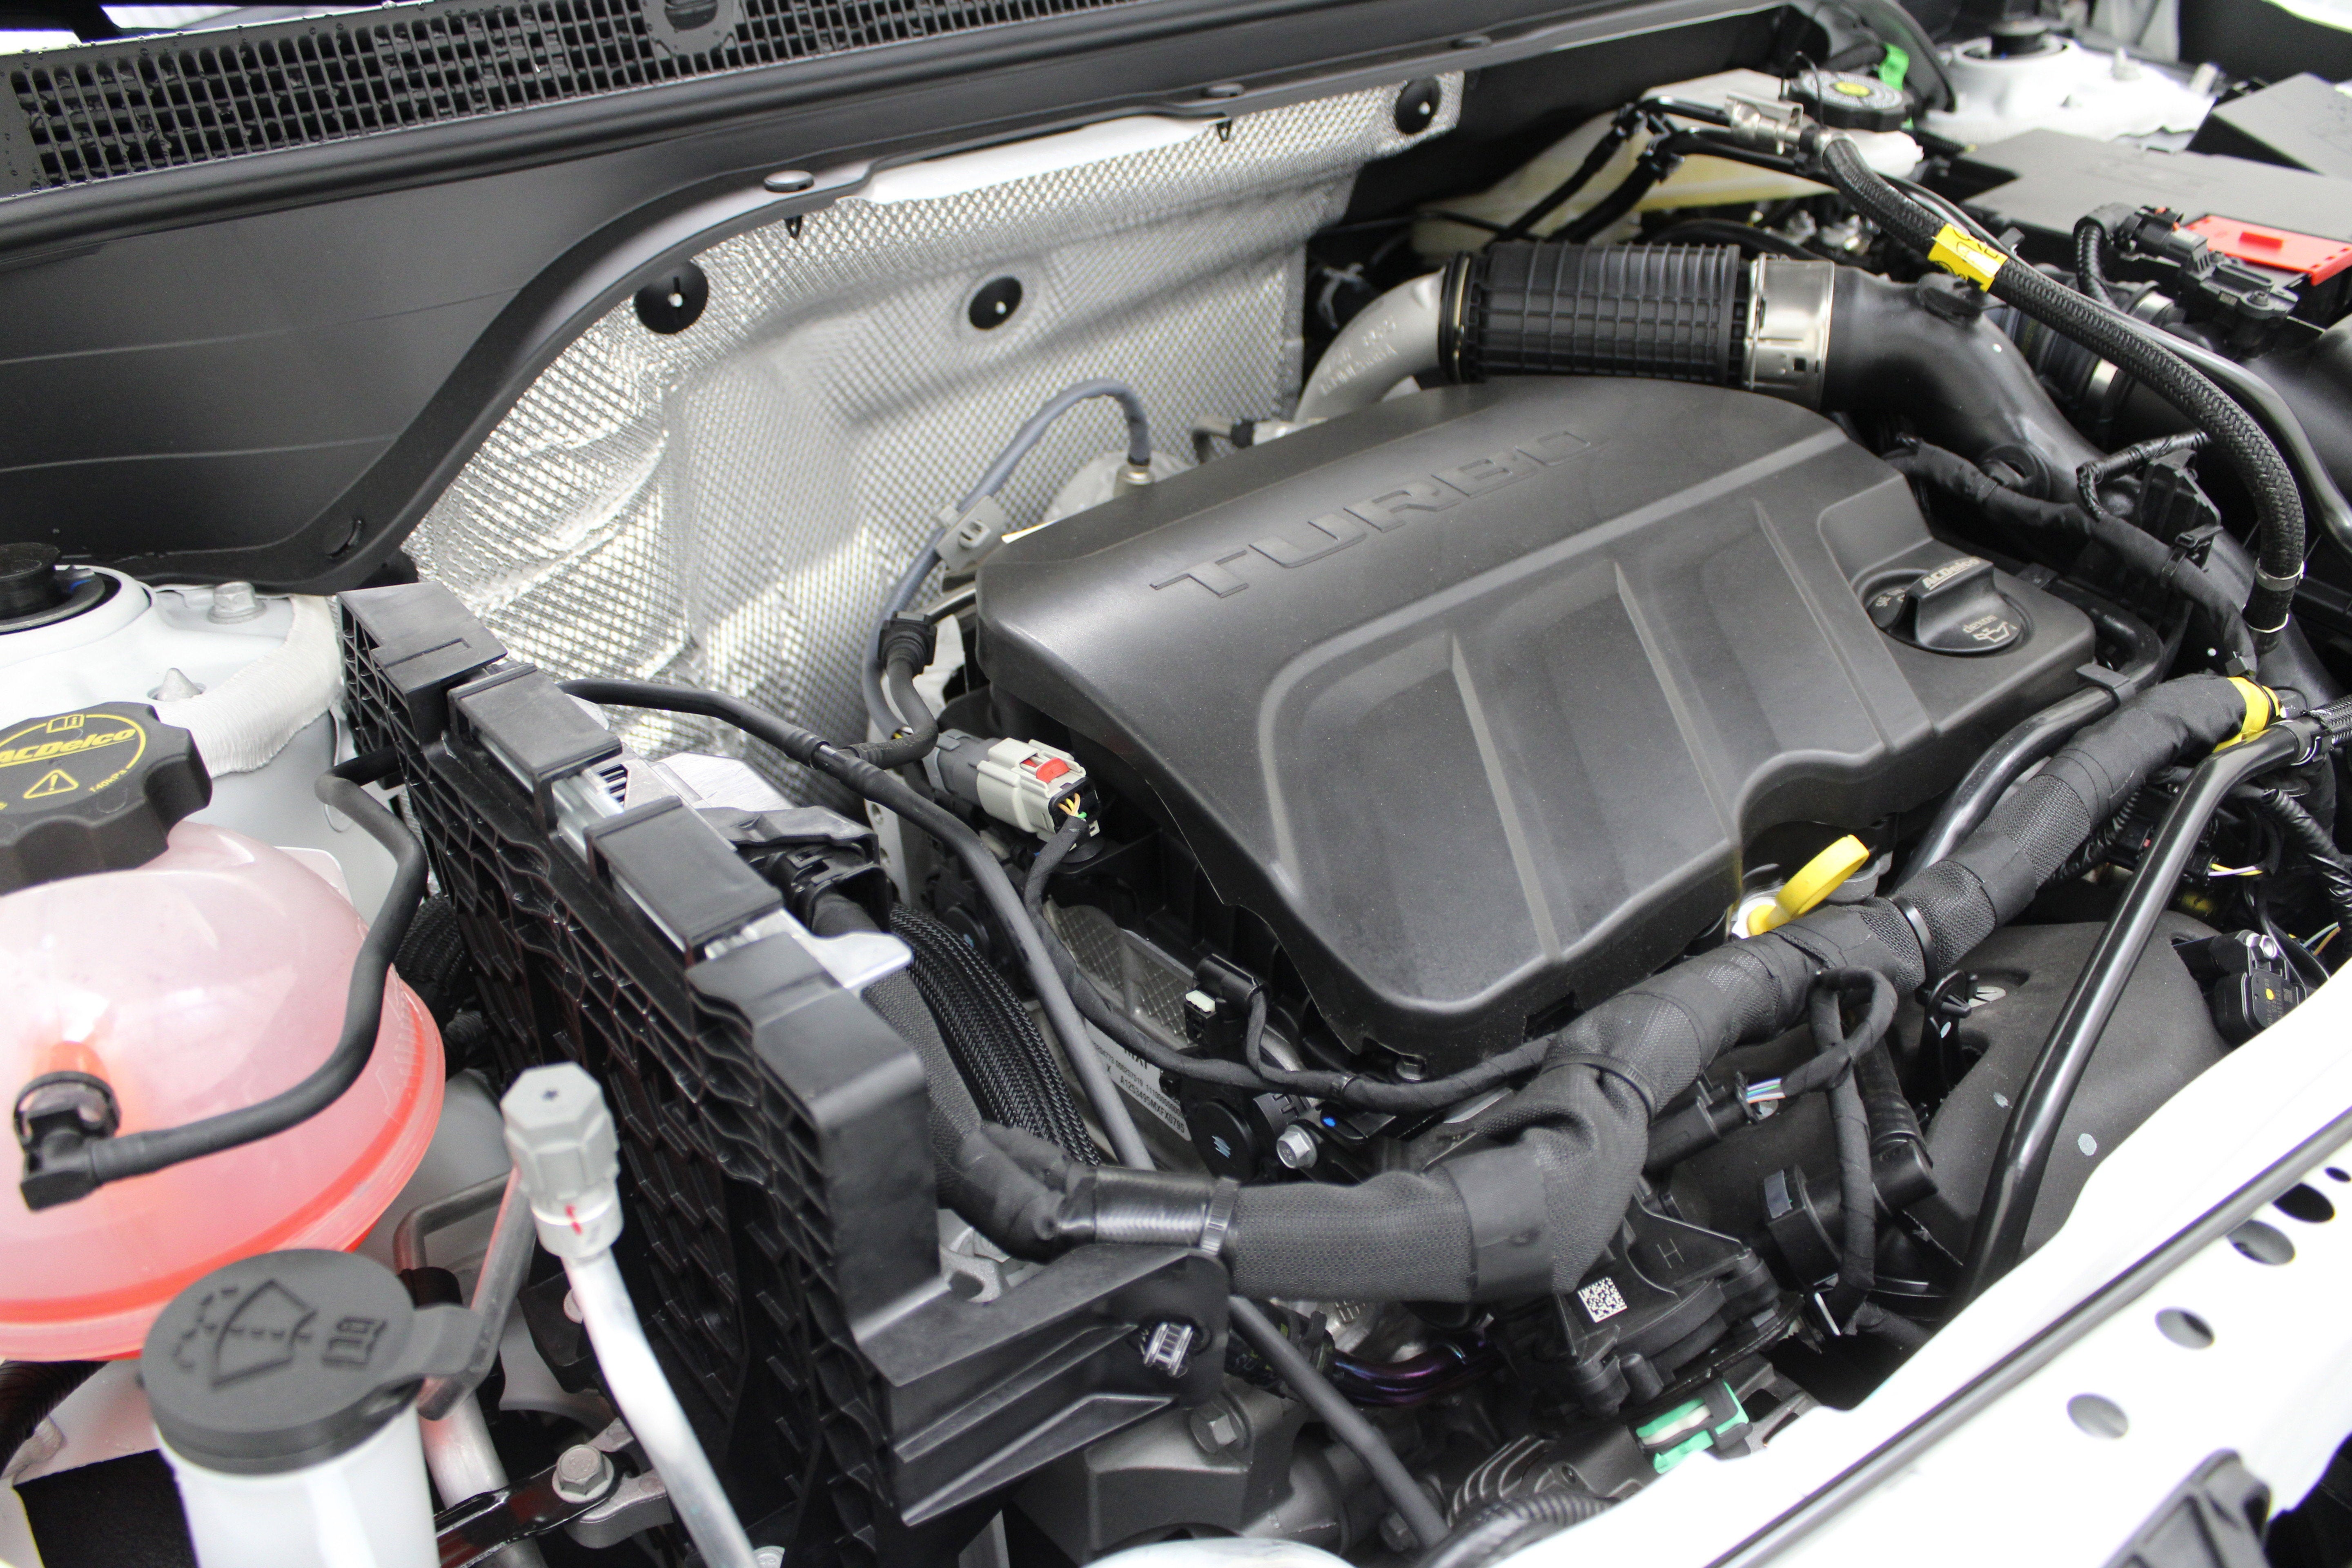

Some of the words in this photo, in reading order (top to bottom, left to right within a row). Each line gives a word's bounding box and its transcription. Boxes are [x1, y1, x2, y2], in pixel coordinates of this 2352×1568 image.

[1149, 423, 1611, 599] TURBO
[1922, 558, 1980, 589] ACDelco
[1963, 615, 1998, 633] dexos
